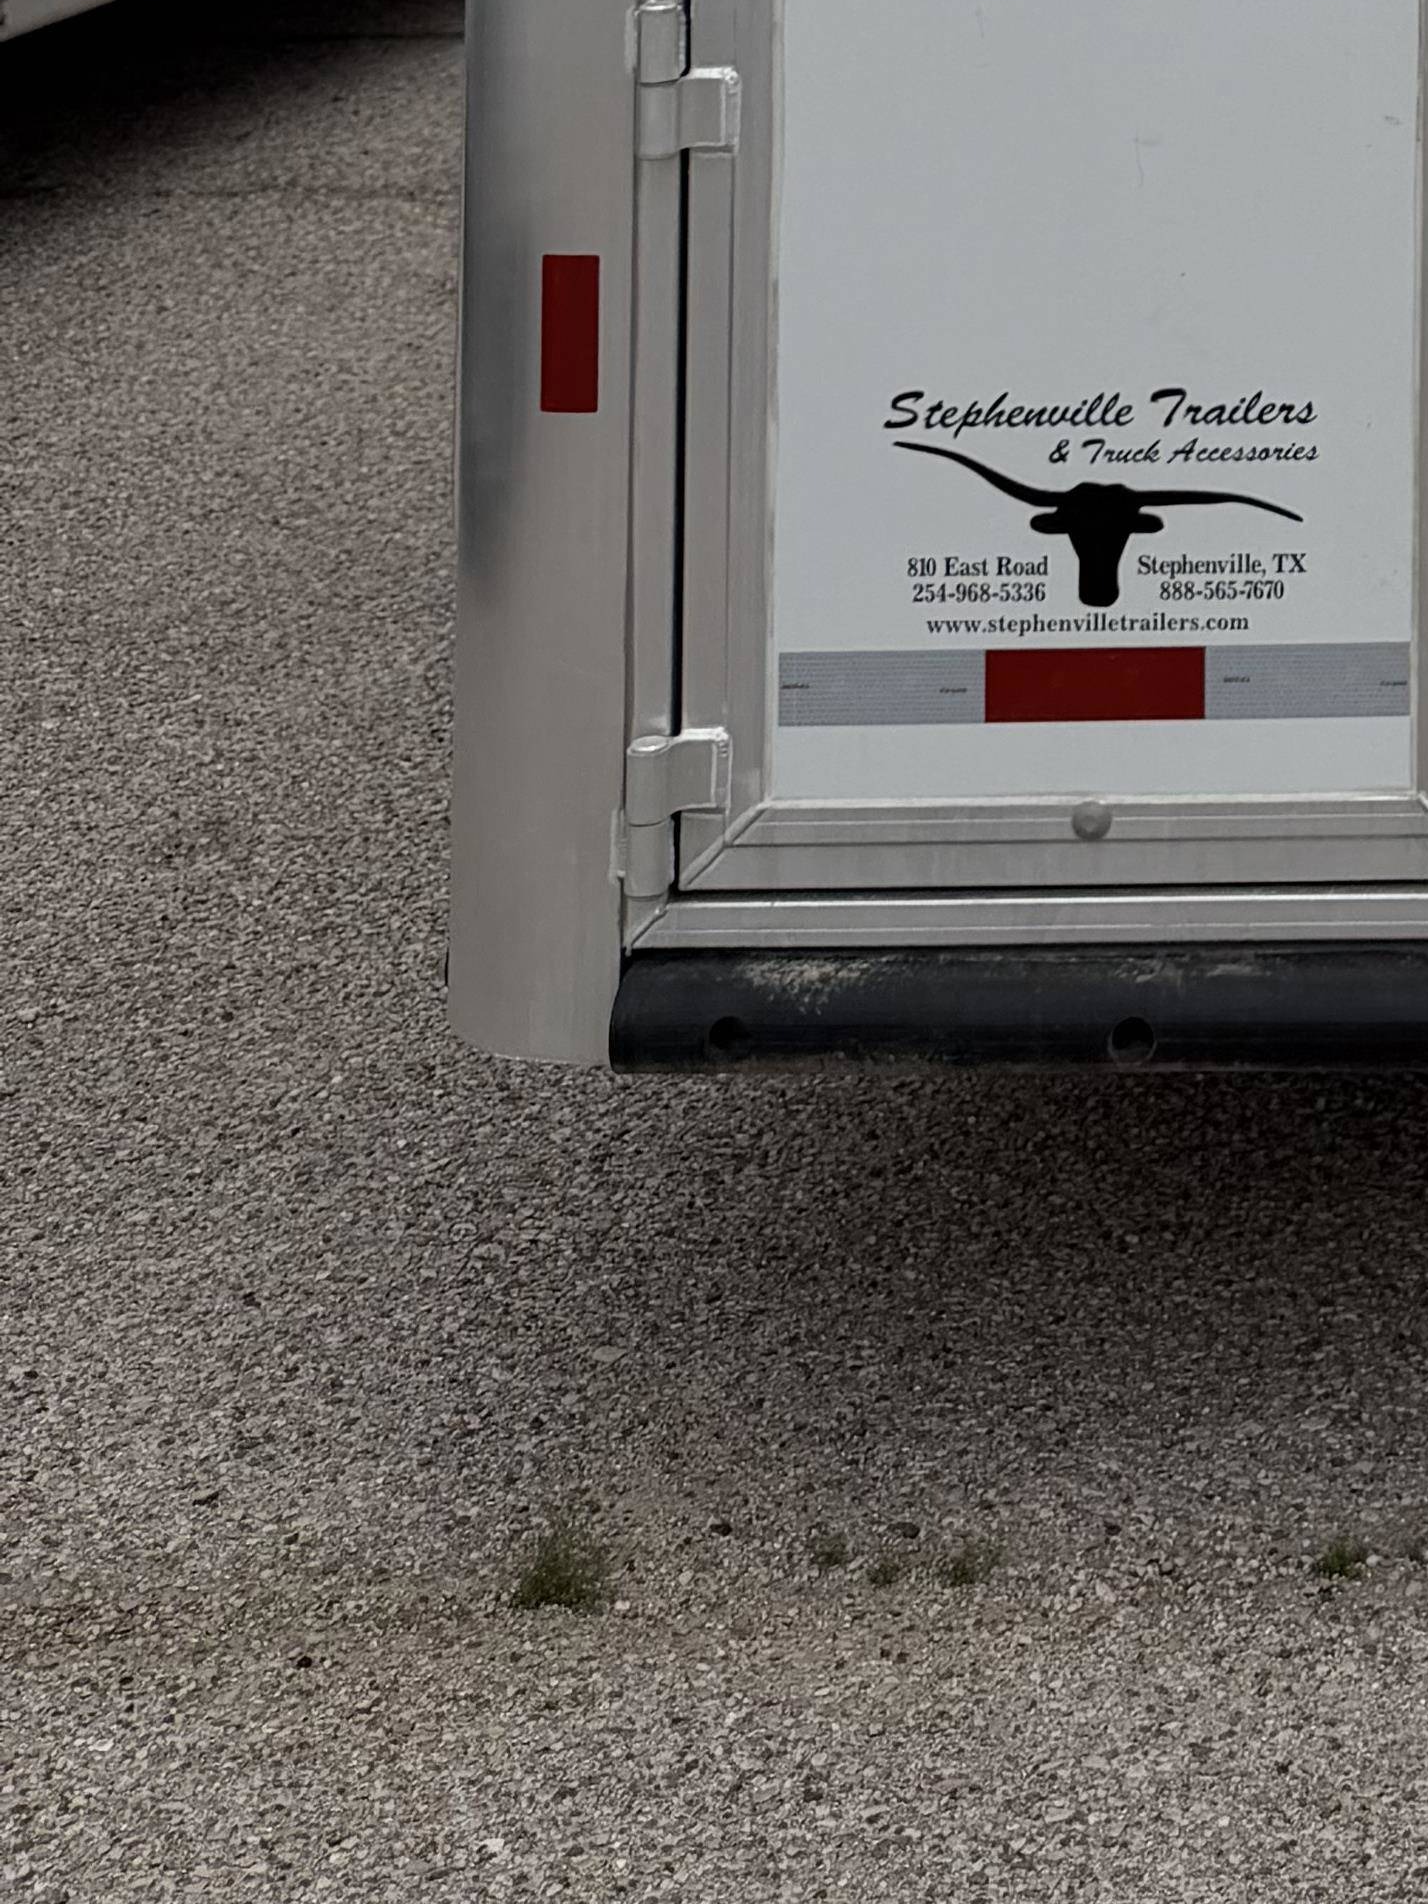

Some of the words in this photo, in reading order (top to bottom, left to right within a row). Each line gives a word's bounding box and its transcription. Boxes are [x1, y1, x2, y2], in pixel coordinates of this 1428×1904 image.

[884, 391, 1135, 439] Stephenville
[1150, 387, 1318, 428] Trailers
[1049, 439, 1070, 464] &
[1081, 438, 1161, 465] Truck
[1166, 437, 1319, 465] Accessories
[907, 557, 937, 577] 810
[944, 556, 988, 577] East
[996, 555, 1049, 576] Road
[1137, 553, 1267, 580] Stephenville,
[1272, 552, 1307, 574] TX
[912, 582, 1046, 603] 254-968-5336
[1159, 579, 1285, 601] 888-565-7670
[926, 612, 1250, 637] www.stephenvilletrailers.com
